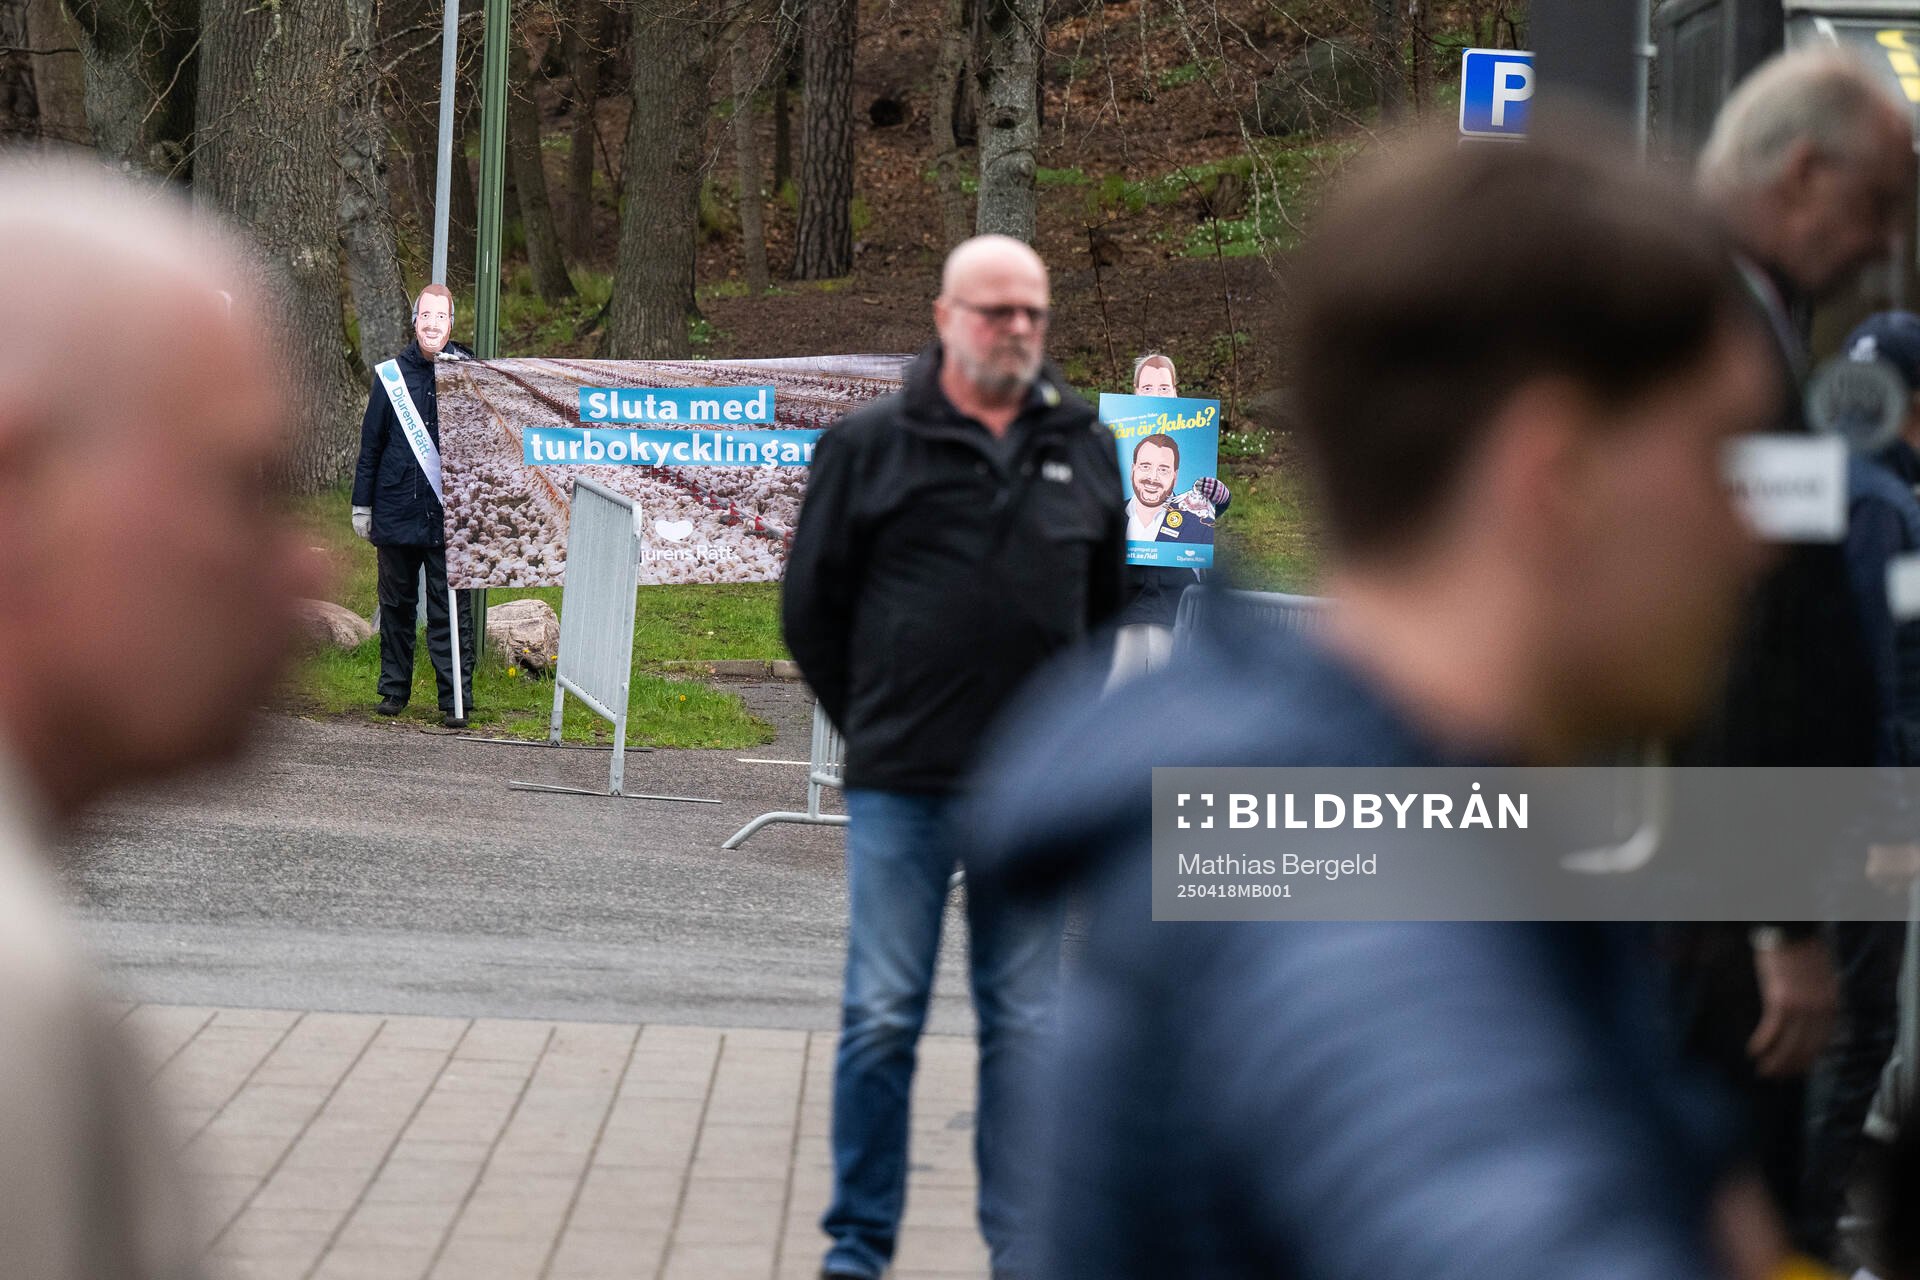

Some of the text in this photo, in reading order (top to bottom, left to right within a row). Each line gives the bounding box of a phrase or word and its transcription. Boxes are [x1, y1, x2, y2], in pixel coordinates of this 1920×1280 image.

[1491, 61, 1536, 126] P
[588, 389, 766, 420] Sluta med
[1156, 406, 1216, 435] Jakob?
[392, 386, 430, 459] Djurens Rätt.
[531, 430, 816, 470] turbokycklingar
[640, 546, 694, 565] jurens
